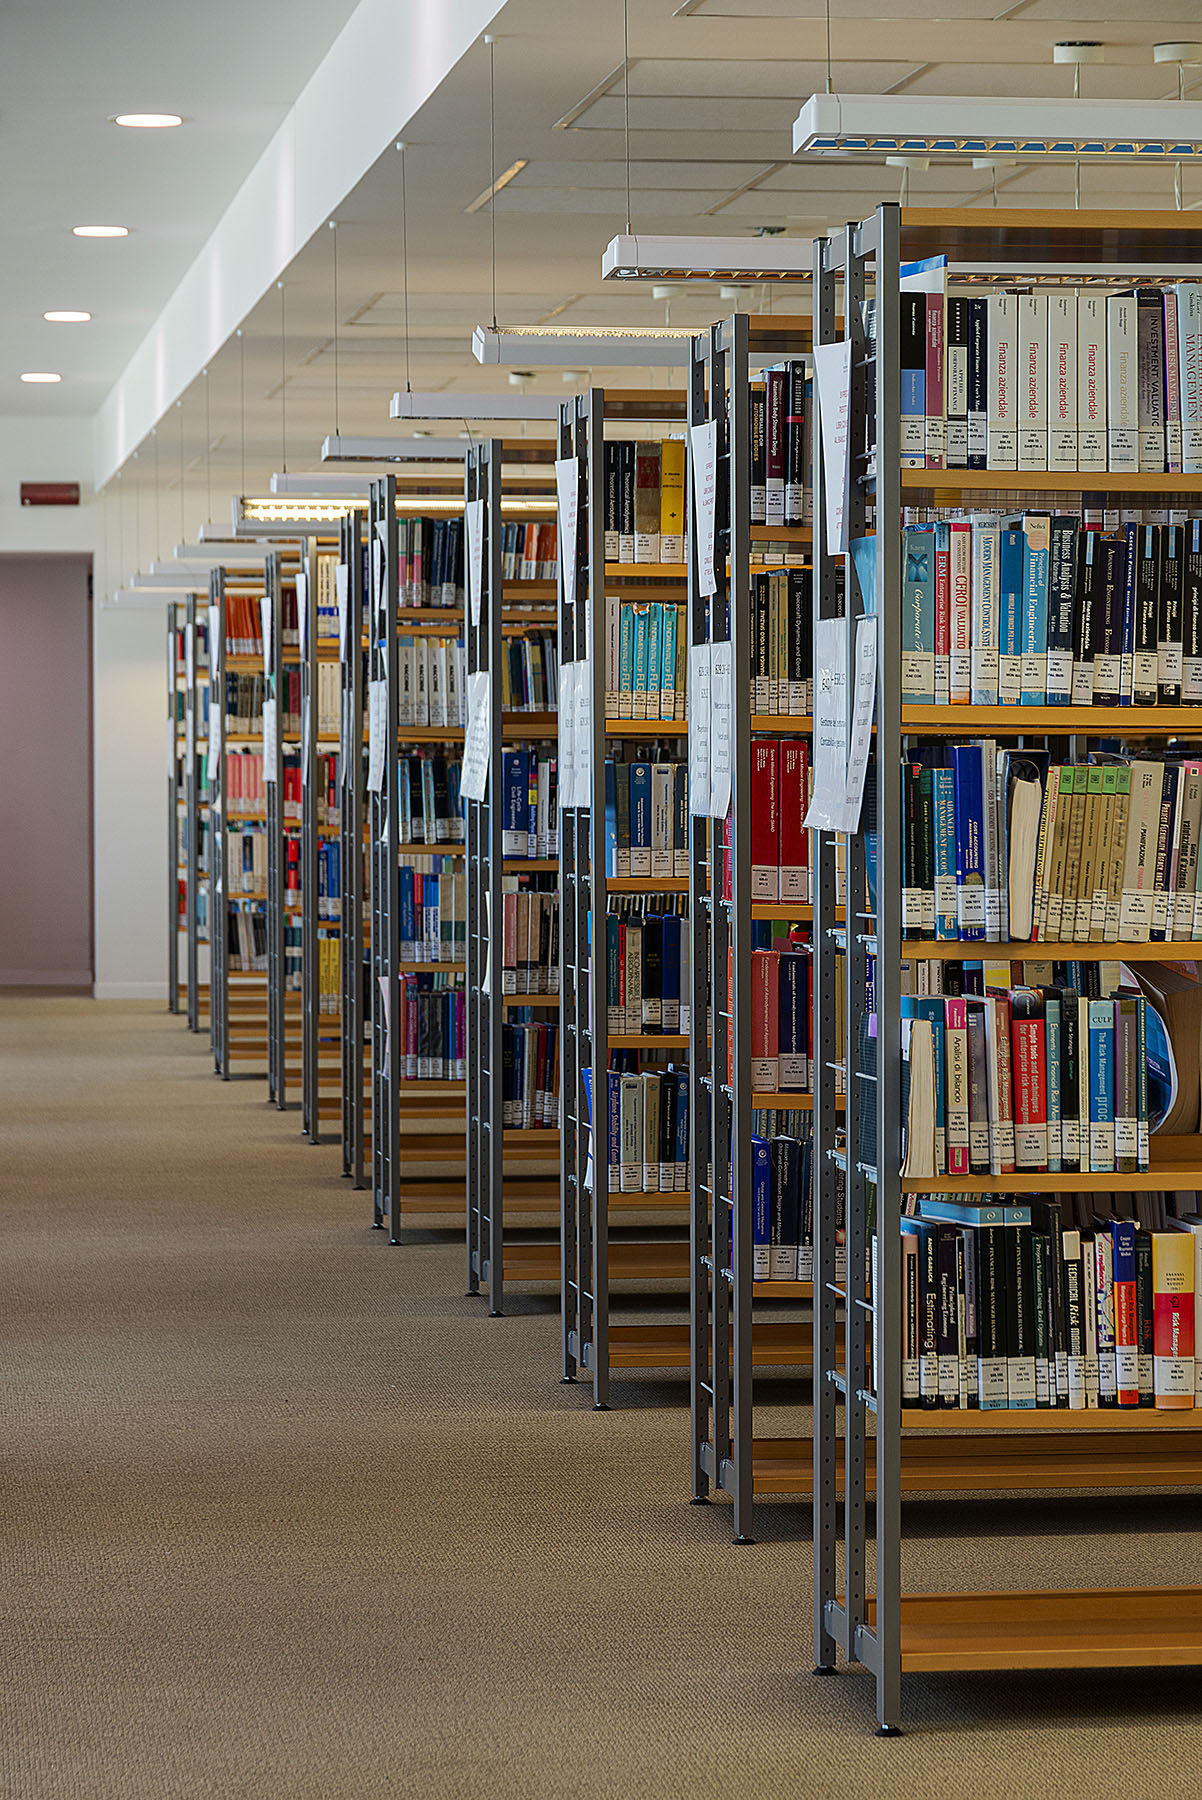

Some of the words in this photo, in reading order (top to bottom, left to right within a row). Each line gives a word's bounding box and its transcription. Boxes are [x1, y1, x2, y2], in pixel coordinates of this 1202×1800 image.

[998, 342, 1008, 375] Finanza
[1029, 342, 1038, 375] Finanza
[1059, 343, 1068, 376] Finanza
[1088, 344, 1098, 377] Finanza
[1150, 316, 1159, 377] INVESTMENT
[1120, 352, 1129, 384] Finanza
[998, 378, 1008, 418] aziendale
[1029, 378, 1038, 418] aziendale
[1059, 378, 1068, 419] aziendale
[1088, 379, 1098, 420] aziendale
[1120, 386, 1129, 427] aziendale
[982, 537, 994, 561] MODERN
[1052, 530, 1061, 541] Using
[1062, 530, 1073, 559] Business
[938, 556, 946, 577] ERM
[1028, 552, 1038, 596] Financial
[1059, 562, 1072, 590] Analysis
[1106, 548, 1116, 580] ADVANCED
[938, 579, 946, 610] Enterprise
[955, 576, 968, 608] CFROI
[982, 562, 994, 603] MANAGEMENT
[1191, 587, 1199, 605] principi
[912, 589, 924, 638] Corporate
[982, 604, 994, 629] CONTROL
[1059, 602, 1071, 632] Valuation
[1105, 584, 1115, 624] ENGINEERING
[957, 610, 967, 648] VALUATIO
[1026, 599, 1037, 653] Engineering
[1104, 628, 1113, 654] ECONOM
[1138, 828, 1147, 867] PIANIFICAZIONE
[1182, 820, 1191, 857] valutazione
[1179, 858, 1189, 888] d'azienda
[1020, 1024, 1028, 1034] for
[1029, 1024, 1038, 1044] Simple
[954, 1037, 962, 1062] Analisi
[1000, 1036, 1008, 1067] Enterprise
[1019, 1036, 1028, 1072] enterprise
[1030, 1045, 1038, 1060] tools
[954, 1074, 962, 1103] bilancio
[1021, 1073, 1029, 1087] risk
[1098, 1058, 1106, 1095] Management
[611, 1090, 619, 1113] Airplane
[1001, 1083, 1009, 1119] Management
[1030, 1075, 1040, 1113] techniques
[1096, 1097, 1108, 1119] proc
[611, 1114, 619, 1135] Stability
[611, 1137, 619, 1147] and
[1068, 1263, 1078, 1302] TECHNICAL
[924, 1293, 936, 1348] Estimating
[1070, 1304, 1080, 1325] Risk
[1144, 1319, 1152, 1339] RISK
[1172, 1312, 1180, 1326] Risk
[1071, 1327, 1080, 1354] MANAG
